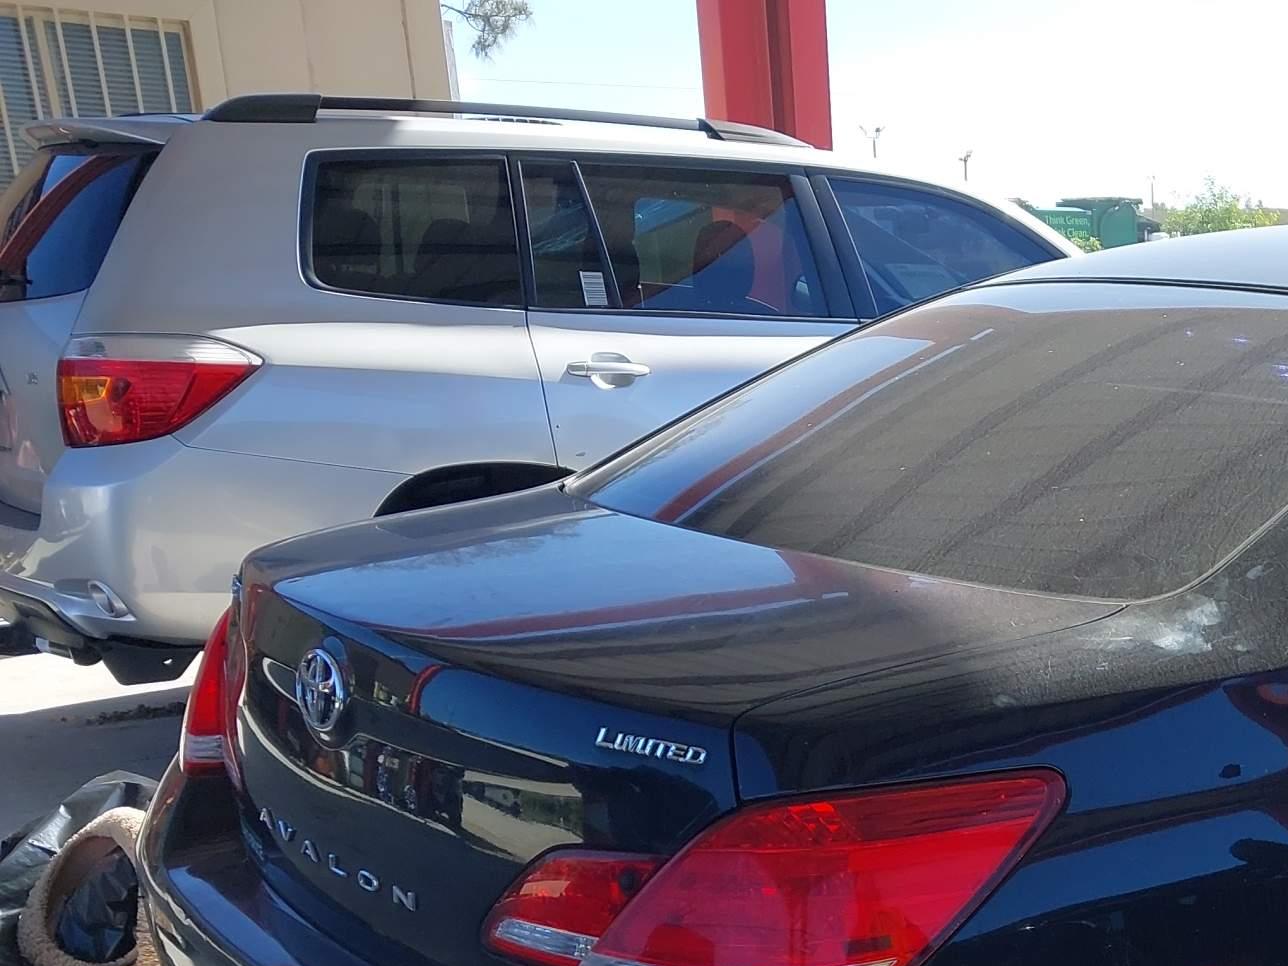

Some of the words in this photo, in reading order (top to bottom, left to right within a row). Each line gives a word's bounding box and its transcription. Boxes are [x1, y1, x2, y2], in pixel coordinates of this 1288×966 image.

[1045, 215, 1065, 225] Think
[595, 727, 707, 765] LIMITED
[259, 807, 417, 912] AVALON
